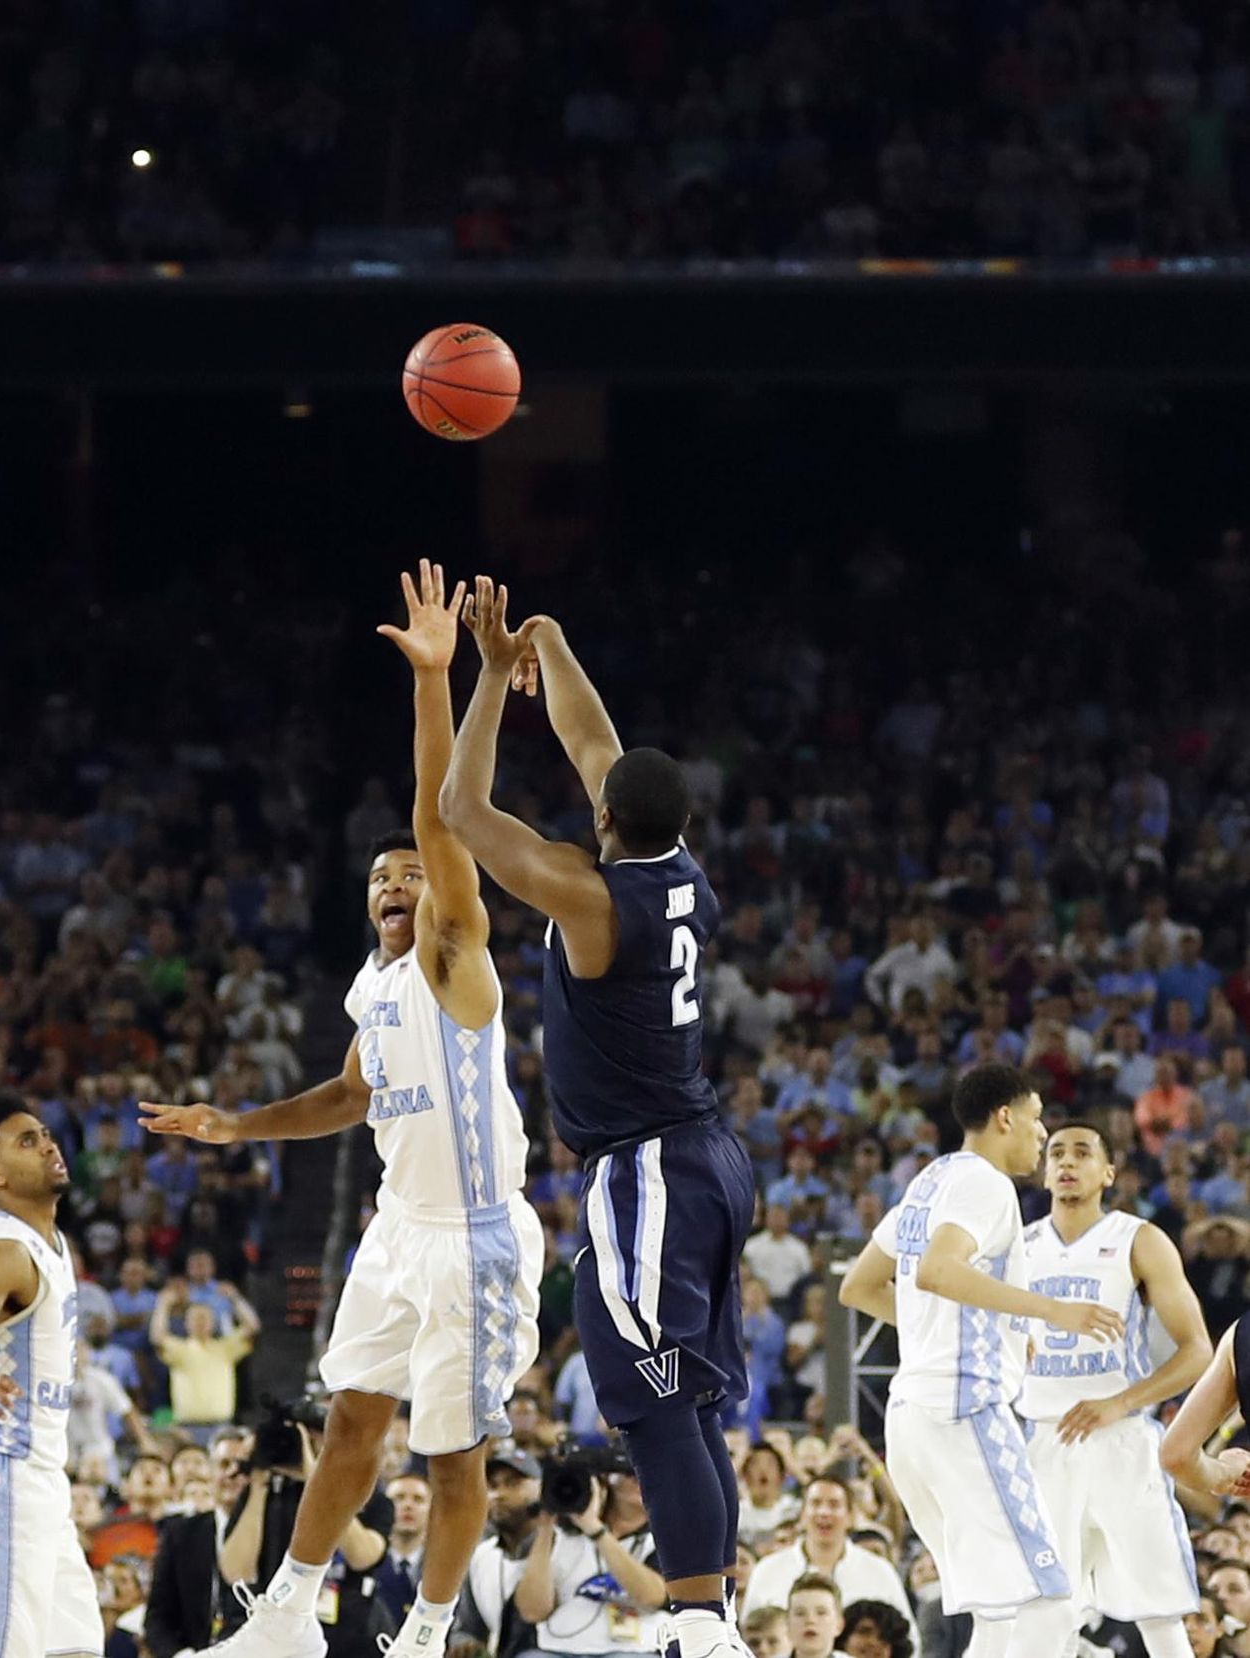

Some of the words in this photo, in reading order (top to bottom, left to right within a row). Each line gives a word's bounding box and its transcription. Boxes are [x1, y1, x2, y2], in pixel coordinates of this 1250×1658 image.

[670, 925, 700, 1027] 2
[368, 1084, 434, 1121] LINA
[634, 1347, 680, 1398] V
